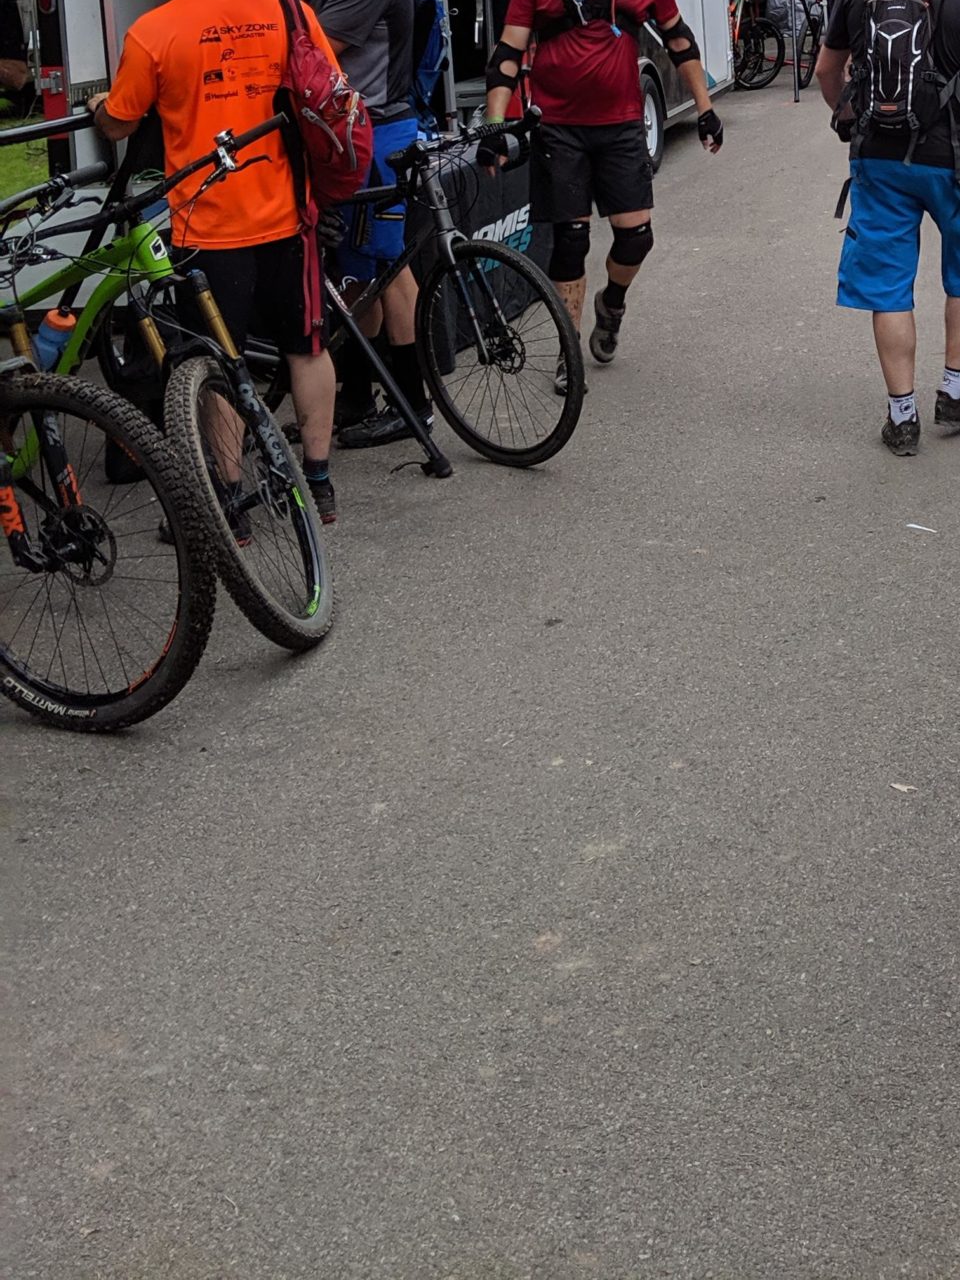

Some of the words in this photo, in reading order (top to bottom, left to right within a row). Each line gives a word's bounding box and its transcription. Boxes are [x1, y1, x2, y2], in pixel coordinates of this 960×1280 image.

[220, 25, 242, 34] SKY
[245, 23, 278, 32] ZONE
[3, 676, 67, 716] MARTELLO
